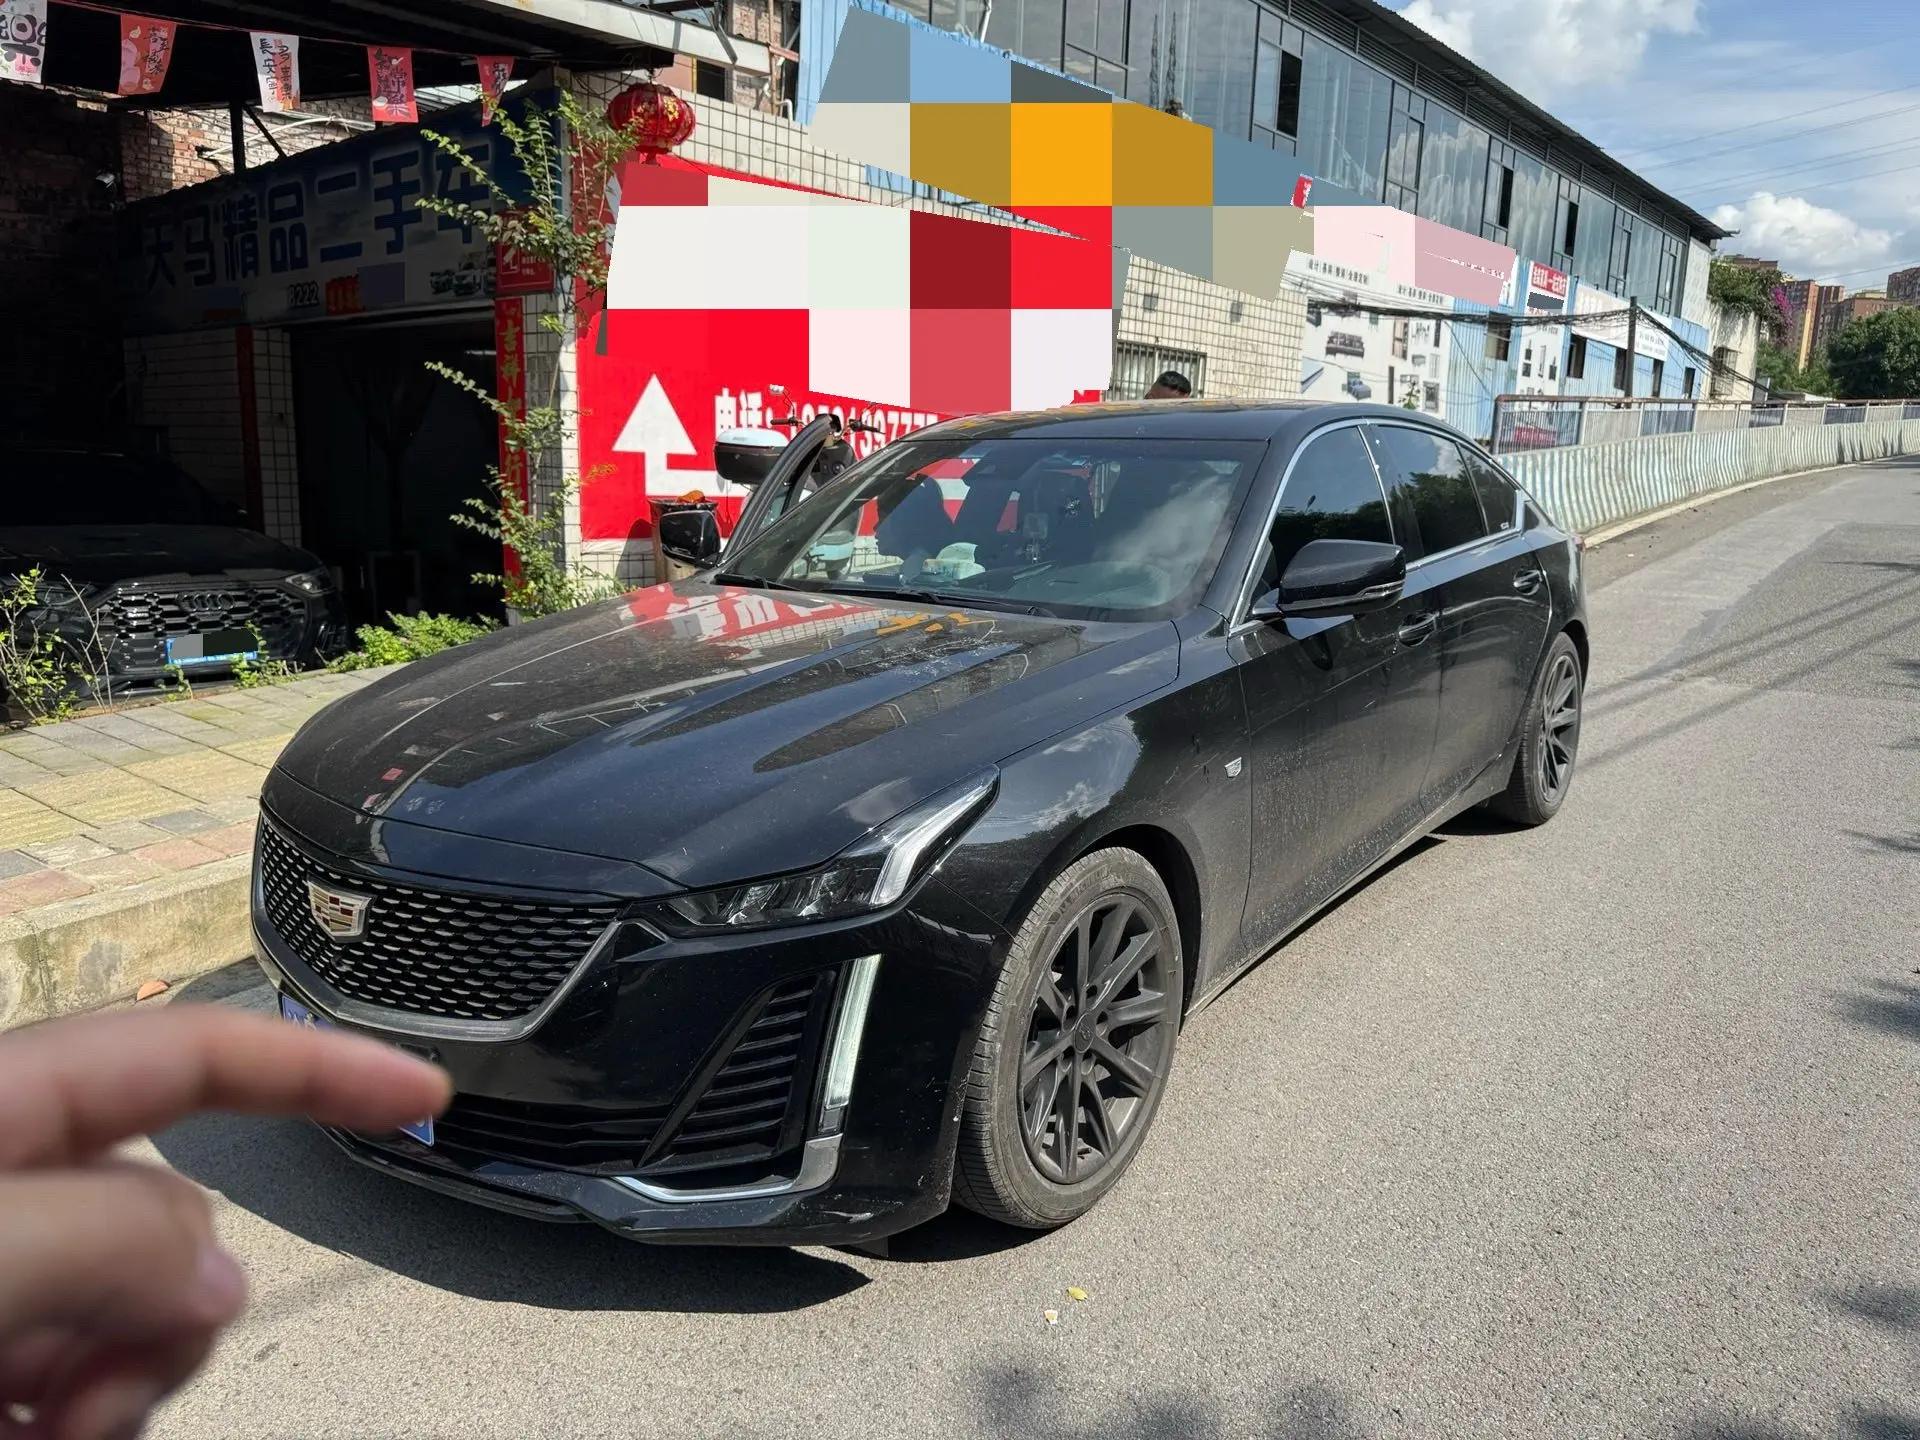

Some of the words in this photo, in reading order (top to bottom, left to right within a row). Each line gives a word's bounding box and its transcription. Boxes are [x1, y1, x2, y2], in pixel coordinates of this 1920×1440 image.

[148, 143, 490, 287] 天马精品二手车
